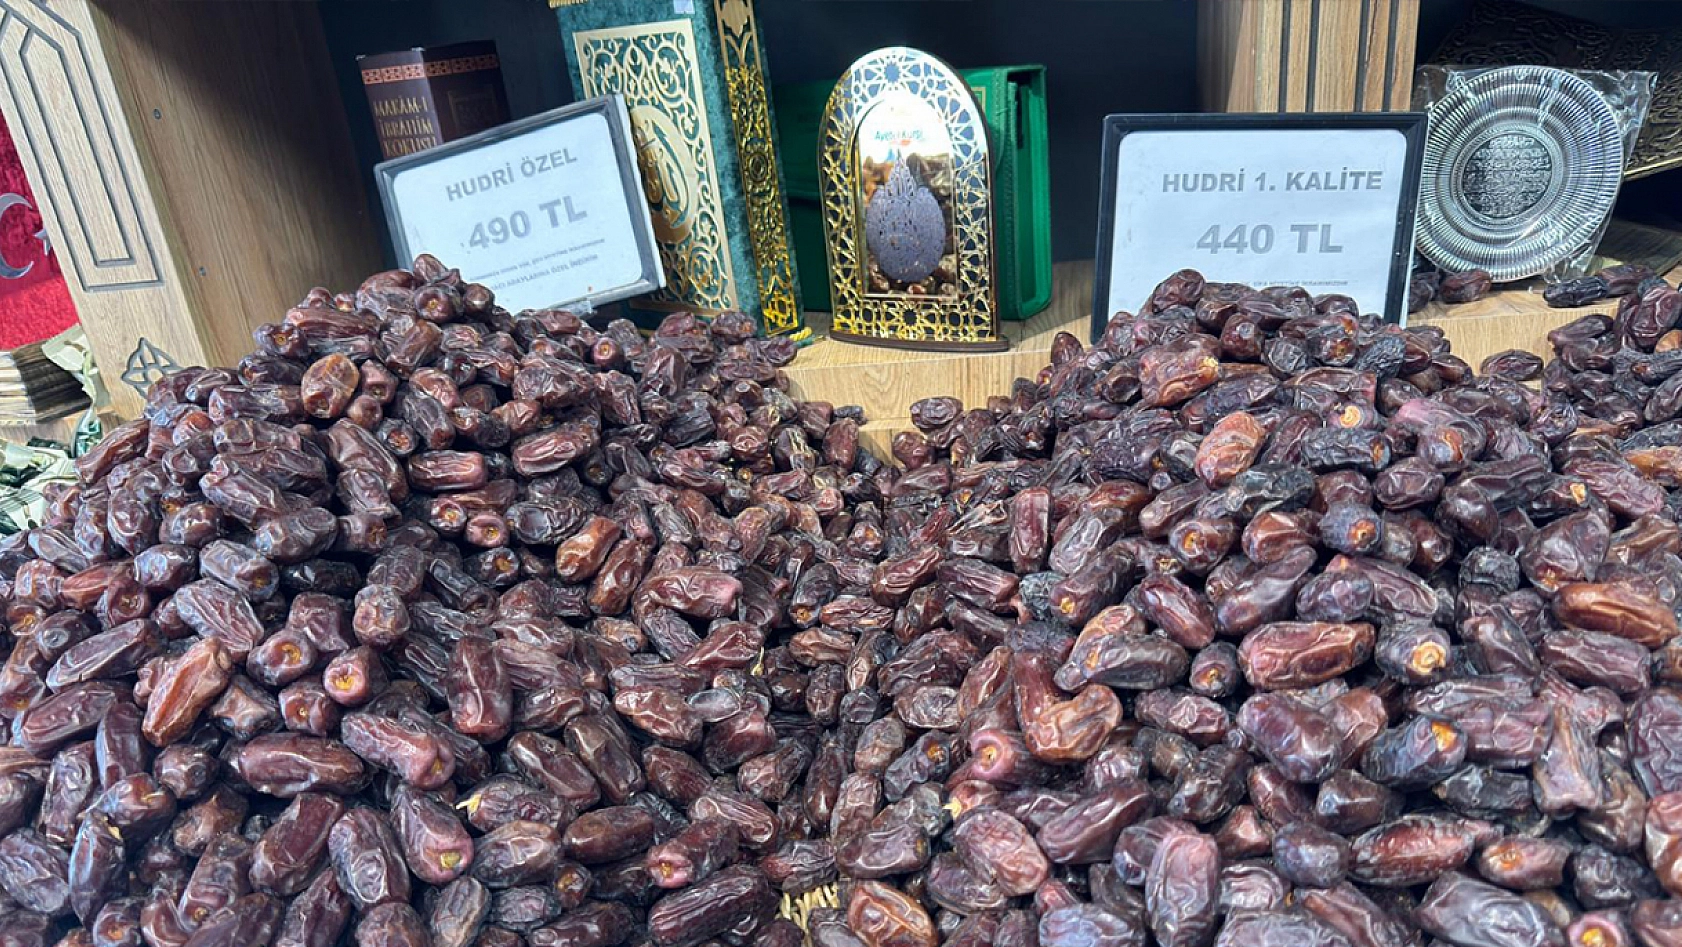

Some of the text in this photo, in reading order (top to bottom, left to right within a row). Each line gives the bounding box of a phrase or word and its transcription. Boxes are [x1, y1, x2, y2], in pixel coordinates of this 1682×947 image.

[446, 148, 577, 201] HUDRİ ÖZEL
[1162, 167, 1382, 192] HUDRİ 1. KALİTE
[469, 195, 587, 249] 490 TL
[1196, 224, 1343, 254] 440 TL
